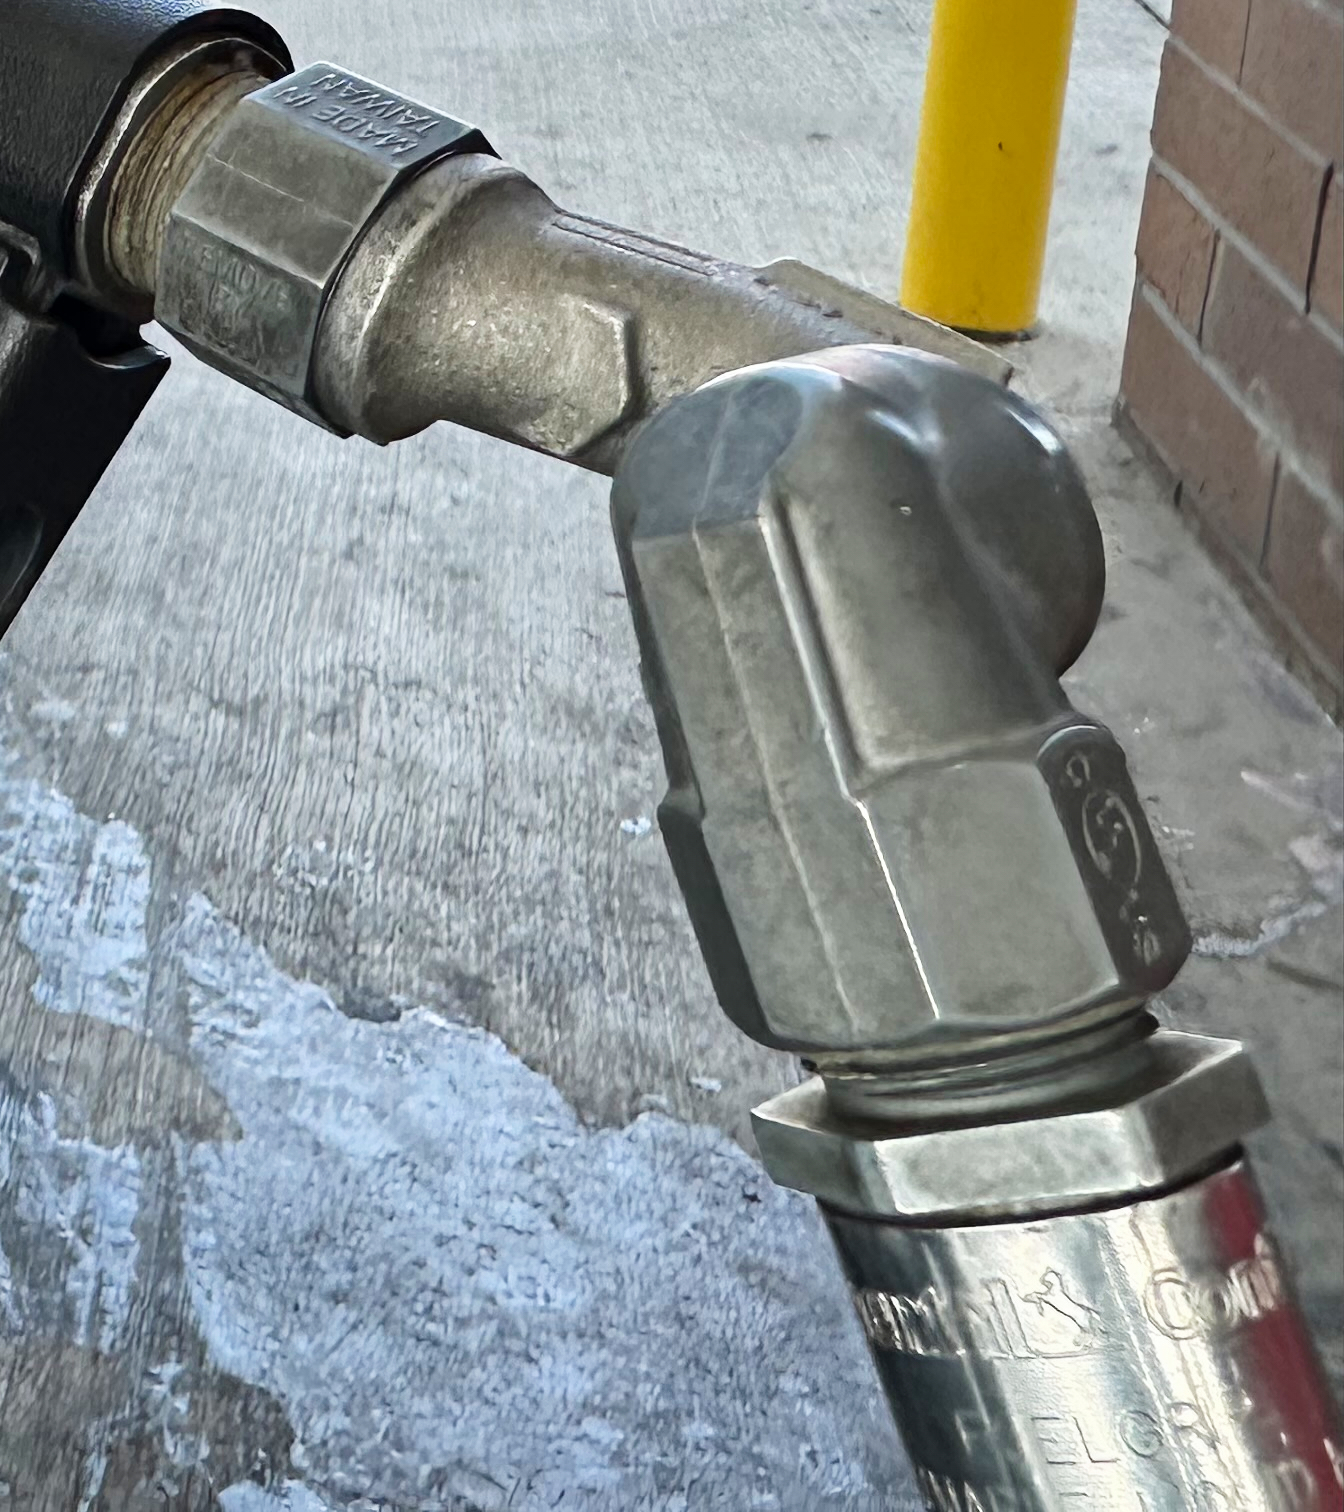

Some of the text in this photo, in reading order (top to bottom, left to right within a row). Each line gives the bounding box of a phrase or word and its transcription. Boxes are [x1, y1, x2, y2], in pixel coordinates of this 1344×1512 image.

[272, 85, 419, 157] MADE IN
[311, 72, 441, 135] TAIWAN
